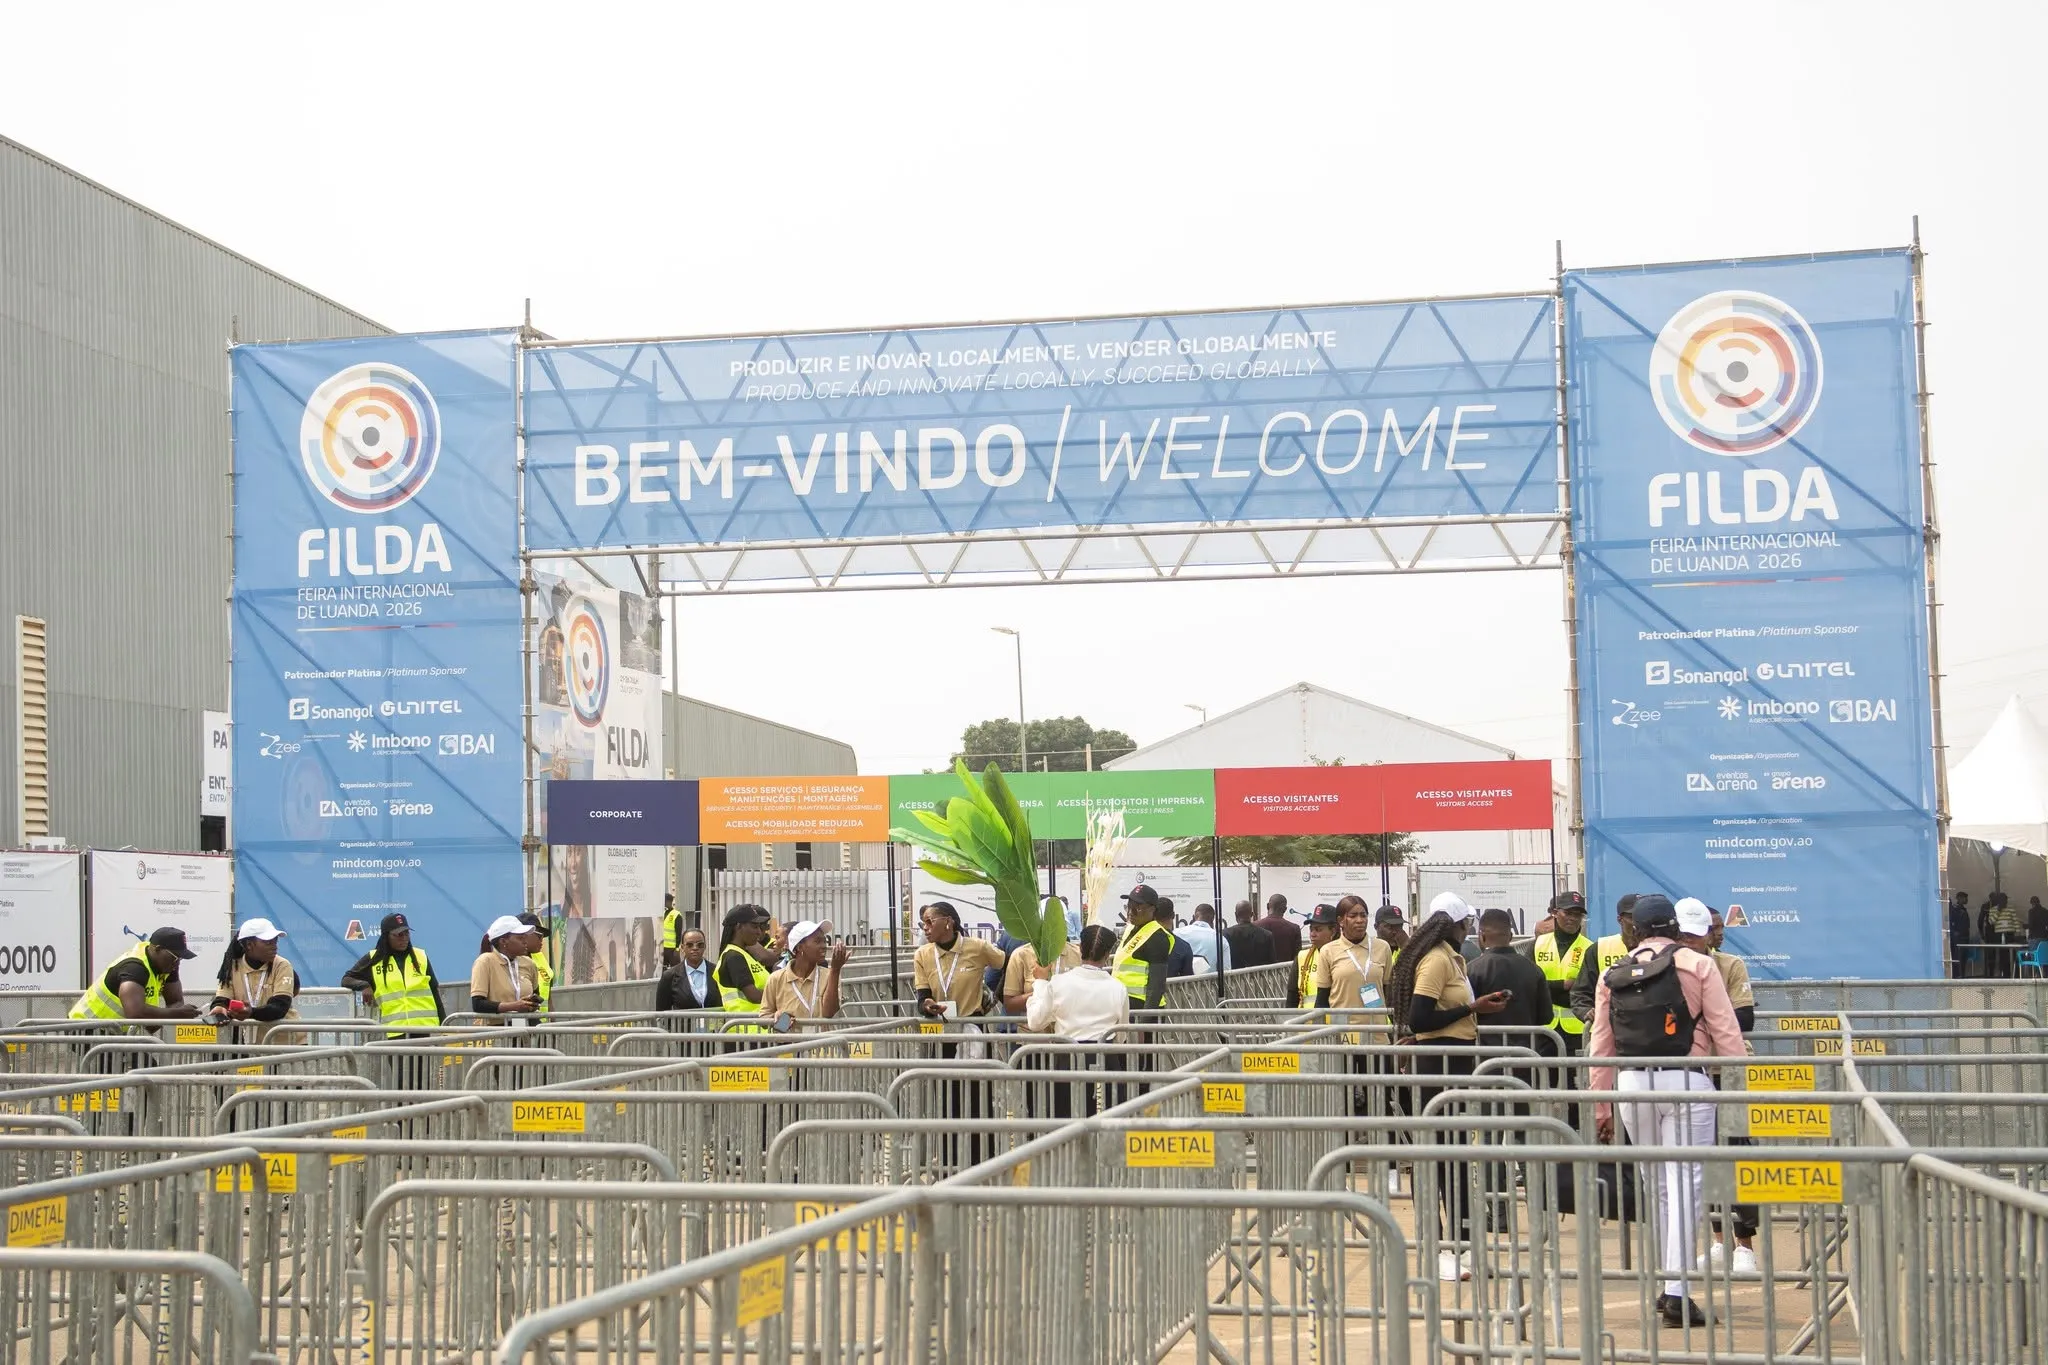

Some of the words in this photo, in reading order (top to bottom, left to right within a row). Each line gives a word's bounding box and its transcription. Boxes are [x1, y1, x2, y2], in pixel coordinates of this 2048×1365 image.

[730, 357, 834, 378] PRODUZIR
[838, 356, 850, 372] E
[856, 352, 932, 372] INOVAR
[937, 343, 1082, 367] LOCALMENTE,
[1087, 340, 1171, 360] VENCER
[1176, 331, 1337, 354] GLOBALMENTE
[745, 380, 842, 402] PRODUCE
[846, 379, 891, 398] AND
[896, 374, 998, 395] INNOVATE
[1003, 367, 1095, 391] LOCALLY,
[1102, 363, 1203, 386] SUCCEED
[1210, 358, 1320, 381] GLOBALLY
[574, 423, 1027, 506] BEM-VINDO
[1099, 405, 1497, 482] WELCOME
[1648, 466, 1840, 528] FILDA
[298, 523, 452, 577] FILDA
[1650, 538, 1697, 554] FEIRA
[1702, 532, 1840, 552] INTERNACIONAL
[1651, 558, 1672, 574] DE
[1678, 556, 1749, 572] LUANDA
[1758, 553, 1802, 569] 2026
[298, 588, 338, 602] FEIRA
[341, 582, 454, 600] INTERNACIONAL
[298, 605, 316, 619] DE
[320, 604, 380, 618] LUANDA
[386, 602, 422, 616] 2026
[1638, 628, 1712, 640] Patrocinador
[1715, 628, 1756, 638] Platina
[1814, 624, 1858, 637] Sponsor
[284, 669, 346, 680] Patrocinador
[348, 668, 382, 678] Platina
[430, 666, 468, 678] Sponsor
[1673, 668, 1749, 686] Sonangol
[1776, 662, 1854, 678] UNITEL
[312, 705, 373, 722] Sonangol
[397, 700, 462, 714] UNITEL
[1748, 700, 1820, 716] Imbono
[1856, 699, 1896, 722] BAI
[372, 733, 432, 748] Imbono
[460, 734, 494, 754] BAI
[608, 726, 650, 768] FILDA
[1710, 752, 1754, 761] Organização
[1716, 778, 1758, 791] arena
[1772, 775, 1826, 789] arena
[724, 786, 758, 794] ACESSO
[760, 786, 803, 795] SERVIÇOS
[810, 786, 864, 794] SEGURANÇA
[1416, 790, 1454, 799] ACESSO
[1456, 788, 1513, 798] VISITANTES
[730, 794, 796, 804] MANUTENÇÕES
[804, 794, 858, 803] MONTAGENS
[898, 801, 934, 810] ACESSO
[1020, 800, 1044, 808] ENSA
[1056, 798, 1094, 808] ACESSO
[1096, 798, 1150, 806] EXPOSITOR
[1158, 796, 1204, 806] IMPRENSA
[1243, 795, 1280, 804] ACESSO
[1283, 794, 1339, 803] VISITANTES
[344, 806, 378, 817] arena
[389, 802, 434, 816] arena
[590, 810, 642, 818] CORPORATE
[726, 820, 760, 828] ACESSO
[762, 820, 816, 828] MOBILIDADE
[819, 819, 864, 828] REDUZIDA
[1713, 818, 1756, 826] Organização
[340, 841, 376, 849] Organização
[1705, 836, 1813, 850] mindcom.gov.ao
[332, 857, 421, 870] mindcom.gov.ao
[1752, 914, 1800, 924] ANGOLA
[1538, 952, 1554, 962] 951
[1780, 1018, 1836, 1031] DIMETAL
[176, 1027, 216, 1038] DIMETAL
[1244, 1056, 1296, 1068] DIMETAL
[711, 1071, 767, 1083] DIMETAL
[1748, 1068, 1812, 1082] DIMETAL
[1206, 1088, 1242, 1102] ETAL
[516, 1106, 582, 1121] DIMETAL
[1750, 1108, 1828, 1125] DIMETAL
[1129, 1136, 1212, 1154] DIMETAL
[1740, 1168, 1838, 1187] DIMETAL
[10, 1207, 64, 1234] DIMETAL
